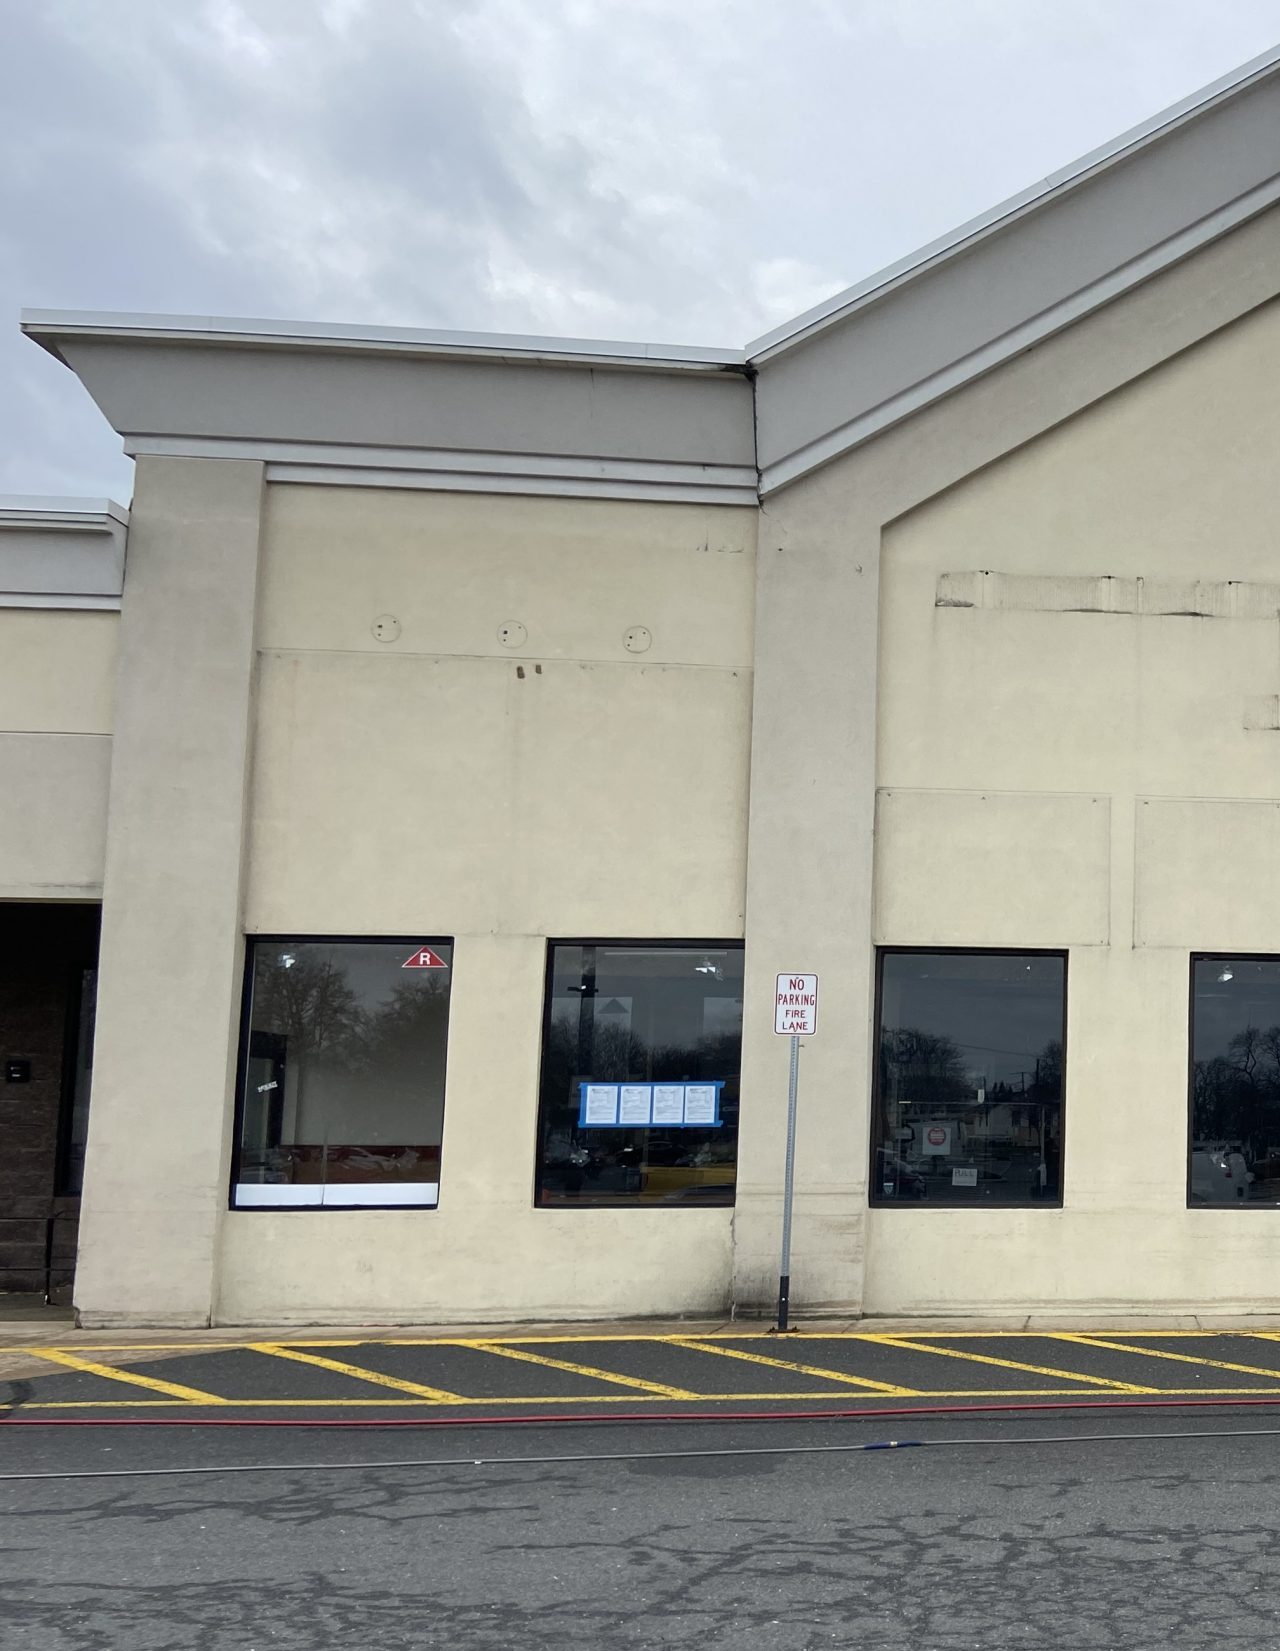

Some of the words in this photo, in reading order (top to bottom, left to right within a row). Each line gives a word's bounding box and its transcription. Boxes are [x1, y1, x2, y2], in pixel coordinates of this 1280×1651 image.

[420, 952, 431, 965] R
[789, 978, 805, 991] NO
[778, 993, 815, 1006] PARKING
[785, 1009, 806, 1018] FIRE
[782, 1021, 809, 1031] LANE
